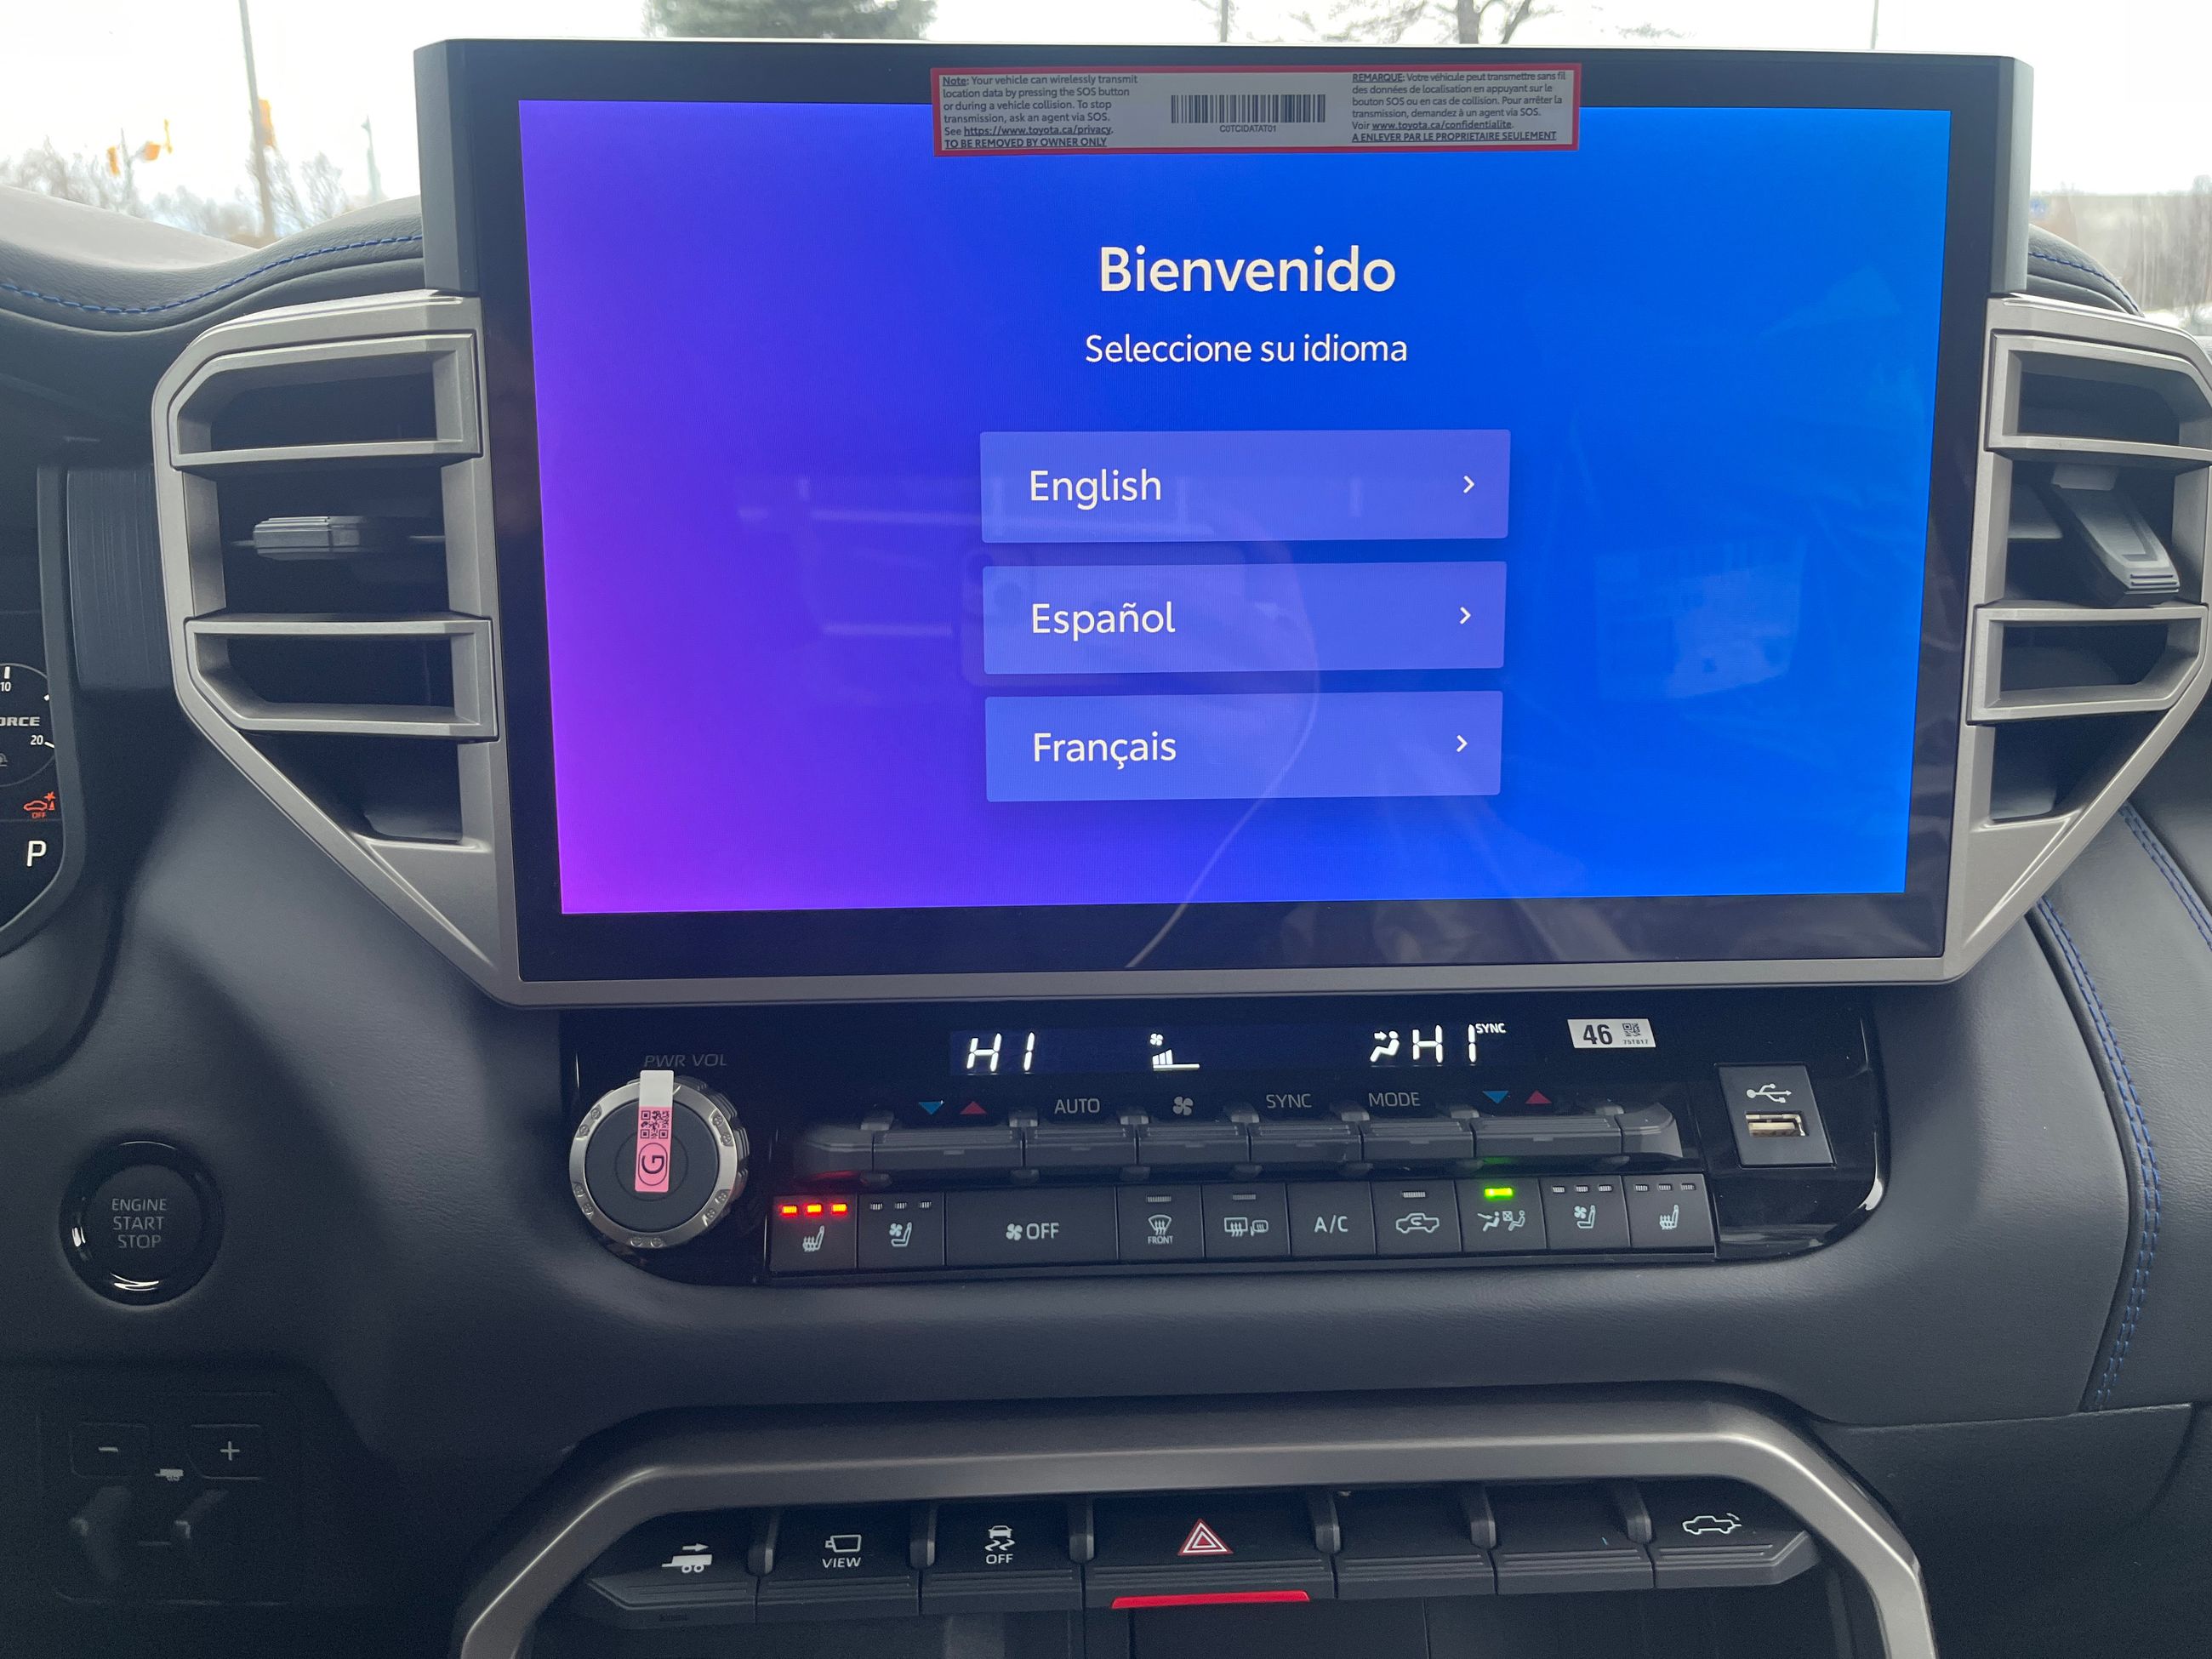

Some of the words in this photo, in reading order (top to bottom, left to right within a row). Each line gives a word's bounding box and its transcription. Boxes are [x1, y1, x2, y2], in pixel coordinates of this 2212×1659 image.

[943, 76, 969, 86] Note:
[971, 76, 994, 85] Your
[995, 76, 1028, 84] vehicle
[1050, 75, 1096, 85] wirelessly
[1098, 75, 1137, 84] transmit
[1353, 73, 1405, 83] REMARQUE:
[1406, 73, 1429, 82] Votre
[1430, 72, 1464, 82] véhicule
[1467, 72, 1485, 83] peut
[1488, 72, 1536, 81] transmettre
[1555, 71, 1565, 80] fil
[944, 88, 979, 98] location
[983, 88, 1003, 97] data
[1006, 88, 1016, 99] by
[1018, 88, 1057, 98] pressing
[1060, 88, 1075, 96] the
[1077, 88, 1096, 96] SOS
[1098, 88, 1129, 96] button
[1352, 85, 1367, 94] des
[1370, 85, 1407, 94] données
[1410, 85, 1421, 94] de
[1422, 84, 1471, 94] localisation
[1486, 85, 1527, 94] appuyant
[955, 101, 986, 111] during
[997, 100, 1030, 109] vehicle
[1032, 100, 1072, 109] collision.
[1077, 100, 1087, 109] To
[1091, 100, 1112, 111] stop
[1386, 97, 1404, 105] SOS
[1462, 96, 1500, 105] collision.
[1502, 96, 1521, 105] Pour
[1554, 95, 1562, 104] la
[944, 114, 1006, 124] transmission,
[1010, 113, 1024, 122] ask
[1041, 114, 1069, 123] agent
[1352, 109, 1409, 119] transmission,
[1411, 109, 1457, 117] demandez
[1459, 108, 1463, 117] à
[1479, 108, 1504, 117] agent
[1520, 107, 1541, 116] SOS.
[1352, 121, 1370, 130] Voir
[945, 140, 959, 149] TO
[961, 140, 972, 149] BE
[975, 139, 1023, 148] REMOVED
[1026, 138, 1038, 148] BY
[1040, 138, 1078, 147] OWNER
[1080, 137, 1107, 147] ONLY
[1352, 134, 1359, 142] A
[1362, 134, 1401, 142] ENLEVER
[1405, 134, 1422, 142] PAR
[1435, 132, 1500, 141] PROPRIETAIRE
[1502, 132, 1556, 140] SEULEMENT
[1099, 245, 1396, 293] Bienvenido
[1085, 334, 1251, 362] Seleccione
[1260, 339, 1298, 362] su
[1303, 334, 1408, 362] idioma
[1029, 469, 1161, 510] English
[1031, 601, 1175, 641] Español
[31, 735, 43, 745] 20
[1033, 732, 1177, 768] Français
[27, 841, 47, 867] P
[1474, 1023, 1507, 1034] SYNC
[1583, 1024, 1612, 1045] 46
[644, 1055, 686, 1067] PWR
[693, 1054, 727, 1066] VOL
[1054, 1098, 1100, 1114] AUTO
[1266, 1092, 1312, 1109] SYNC
[1368, 1092, 1421, 1107] MODE
[641, 1154, 664, 1174] G
[111, 1198, 167, 1211] ENGINE
[112, 1216, 164, 1230] START
[1314, 1215, 1348, 1234] A/C
[1026, 1222, 1059, 1240] OFF
[117, 1234, 162, 1248] STOP
[1148, 1235, 1173, 1245] FRONT
[822, 1556, 862, 1569] VIEW
[985, 1554, 1013, 1565] OFF
